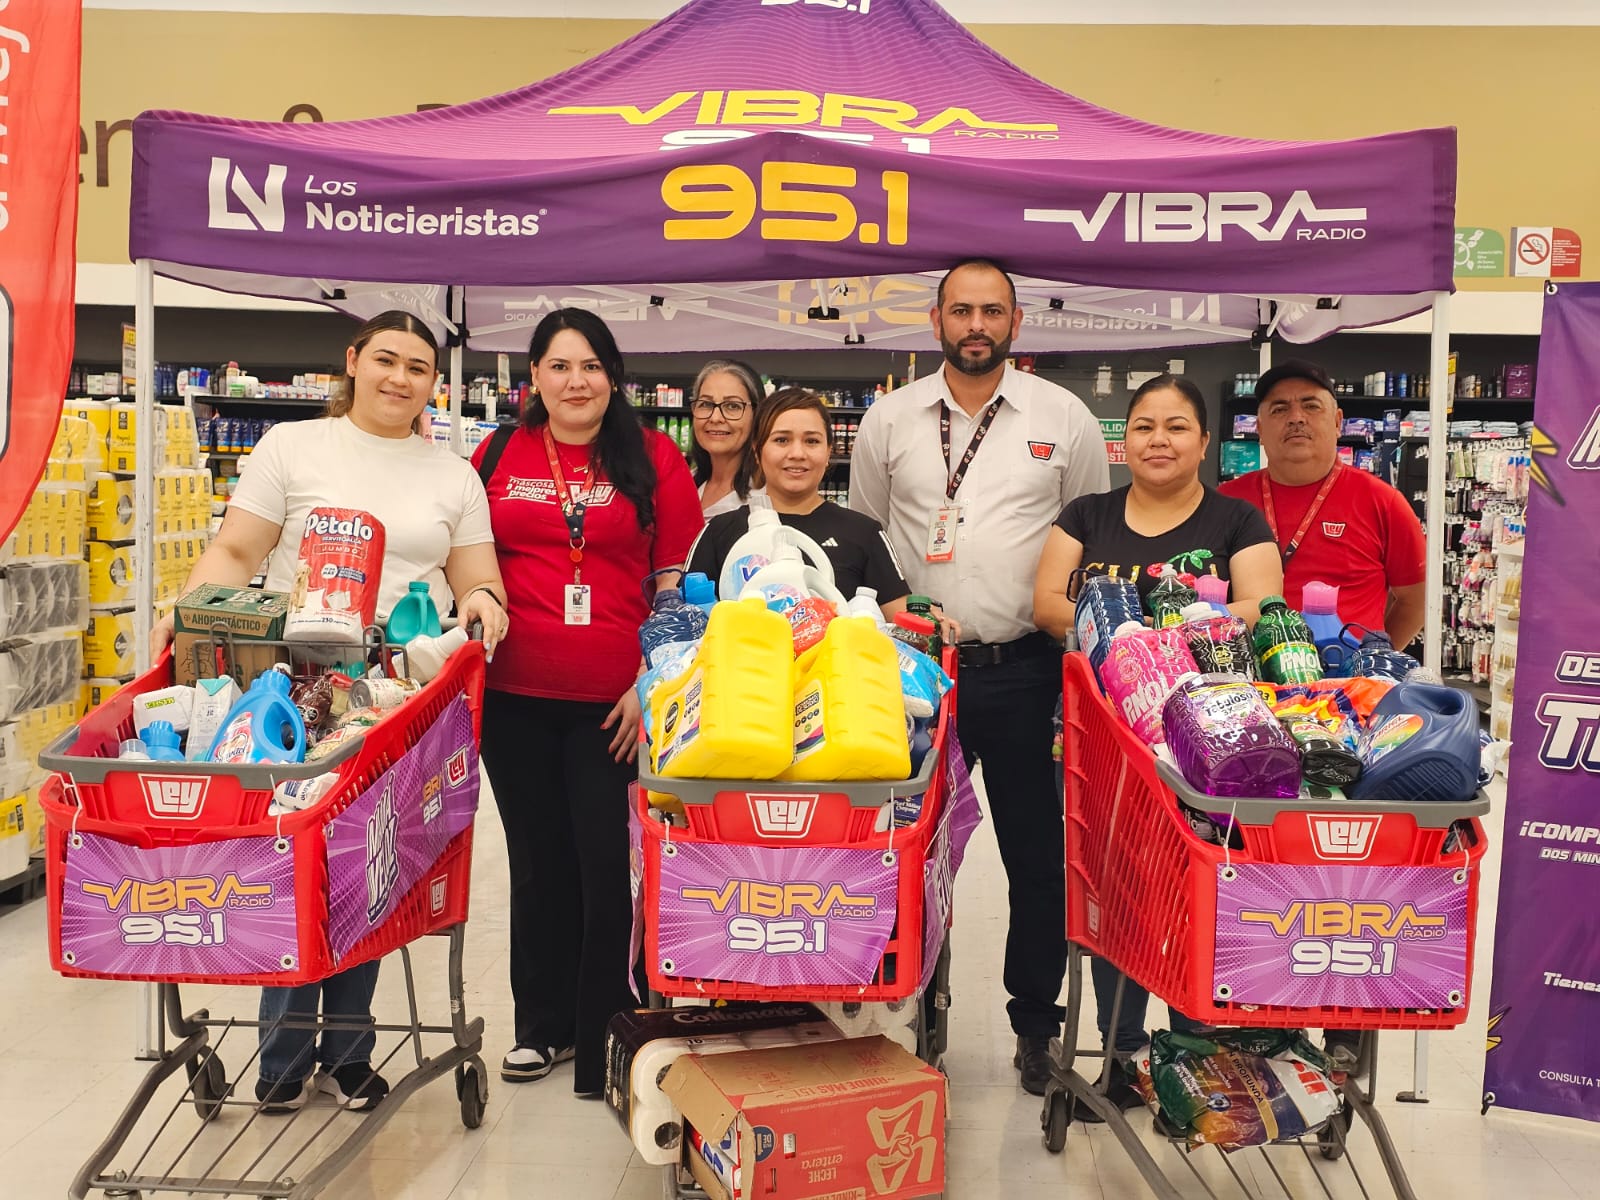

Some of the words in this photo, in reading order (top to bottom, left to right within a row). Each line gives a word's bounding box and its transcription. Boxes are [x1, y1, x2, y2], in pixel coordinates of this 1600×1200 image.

[547, 90, 1058, 134] VIBRA
[954, 129, 1059, 141] RADIO
[305, 174, 357, 196] Los
[661, 161, 909, 245] 95.1
[1024, 190, 1367, 243] VIBRA
[1296, 227, 1366, 241] RADIO
[304, 513, 374, 541] Pétalo
[322, 545, 358, 554] JUMBO
[1541, 848, 1570, 861] DOS
[83, 876, 271, 912] VIBRA
[230, 895, 272, 906] RADIO
[681, 881, 876, 917] VIBRA
[833, 908, 875, 918] RADIO
[1241, 902, 1445, 937] VIBRA
[121, 913, 227, 946] 95.1
[727, 918, 828, 953] 95.1
[1404, 928, 1444, 938] RADIO
[1291, 941, 1396, 976] 95.1
[1232, 1058, 1265, 1105] PROFUNDA
[1539, 1070, 1594, 1087] CONSULTA
[801, 1154, 844, 1170] entera
[808, 1167, 837, 1184] LECHE
